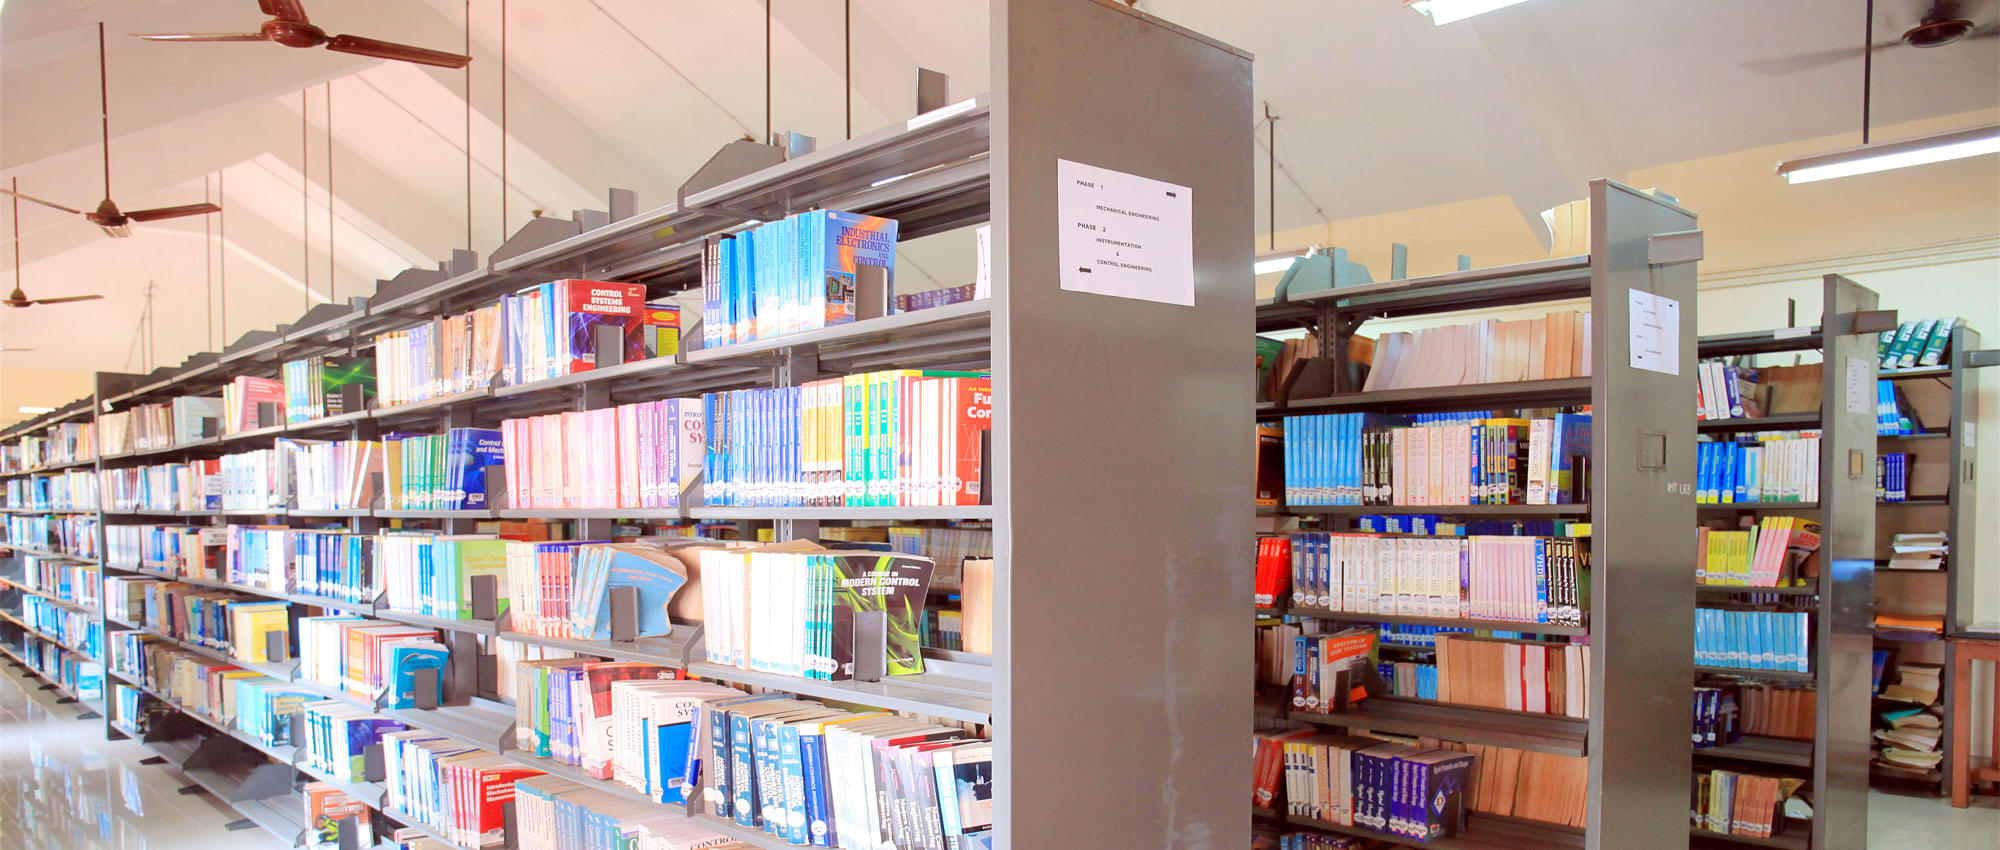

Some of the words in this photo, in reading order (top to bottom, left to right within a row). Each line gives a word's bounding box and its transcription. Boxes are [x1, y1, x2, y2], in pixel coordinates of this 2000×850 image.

[1076, 180, 1095, 189] PHASE
[1096, 204, 1127, 216] MECHANICAL
[1128, 212, 1160, 222] ENGINEERING
[1077, 222, 1096, 231] PHASE
[841, 226, 890, 242] INDUSTRIAL
[836, 235, 890, 252] ELECTRONICS
[1096, 238, 1142, 249] INSTRUMENTATION
[1096, 259, 1119, 267] CONTROL
[1120, 262, 1152, 272] ENGINEERING
[591, 289, 623, 298] CONTROL
[591, 297, 623, 305] SYSTEMS
[583, 303, 631, 314] ENGINEERING
[479, 439, 501, 448] Control
[841, 577, 877, 588] MODERN
[879, 578, 921, 587] CONTROL
[861, 587, 896, 597] SYSTEM
